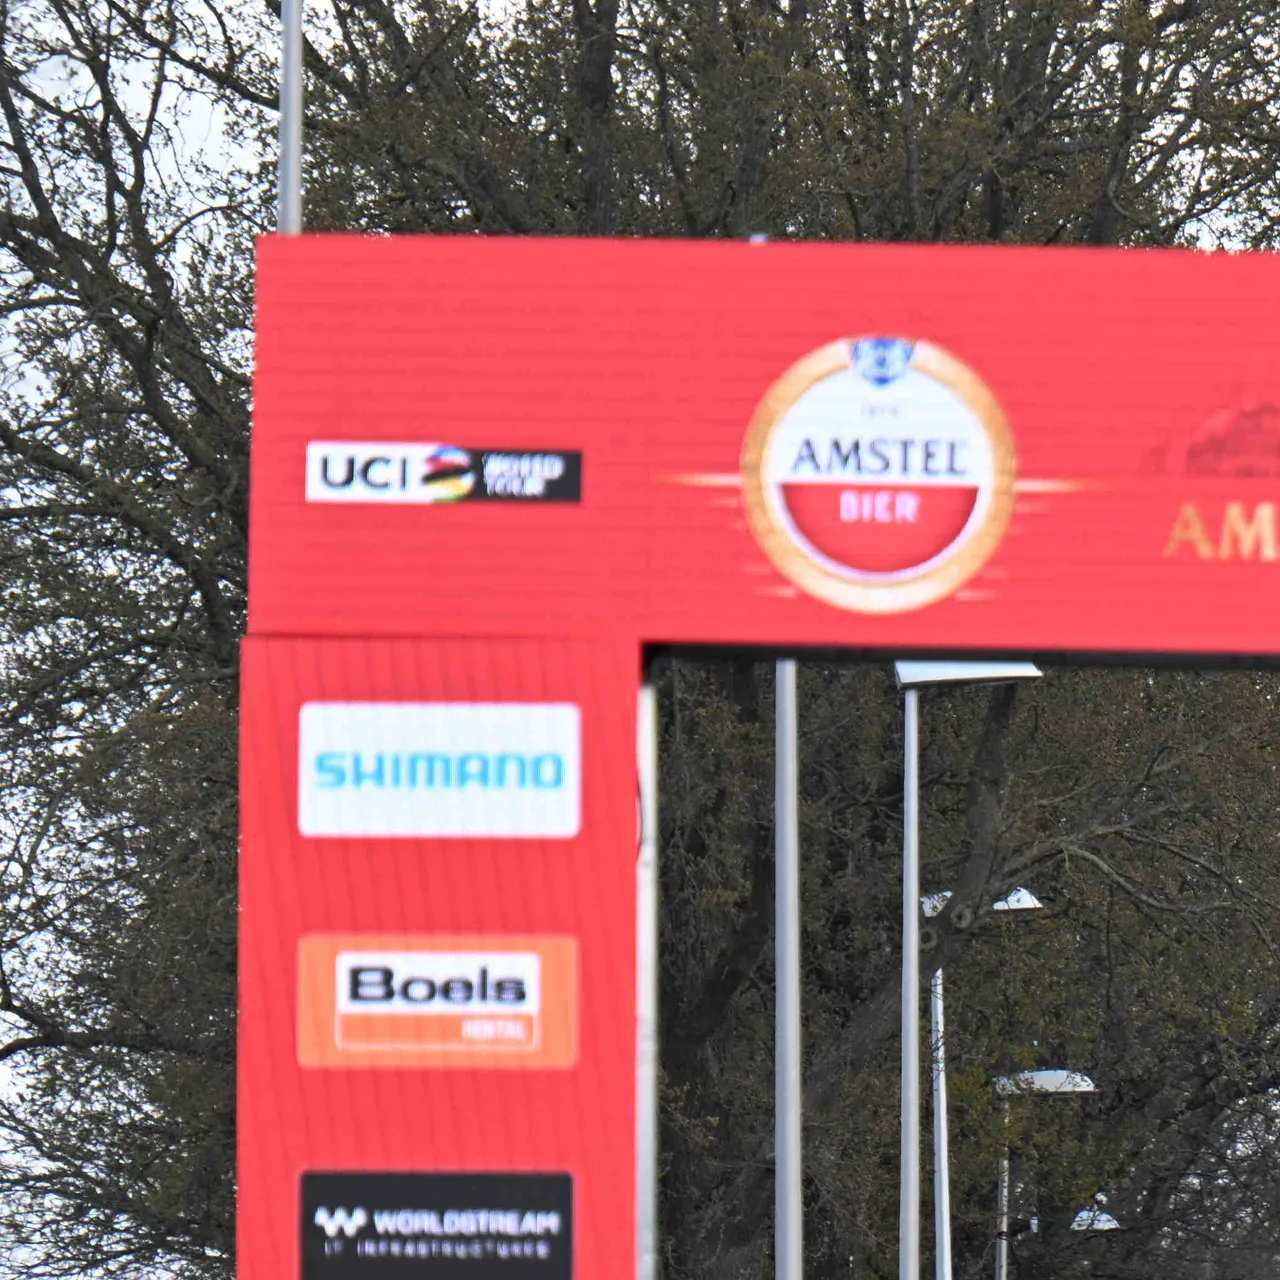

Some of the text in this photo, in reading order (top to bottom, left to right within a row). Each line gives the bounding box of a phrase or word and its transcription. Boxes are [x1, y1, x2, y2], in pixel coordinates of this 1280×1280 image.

[321, 455, 407, 491] UCI
[792, 437, 969, 477] AMSTEL
[839, 489, 921, 523] BIER
[313, 750, 565, 790] SHIMANO
[348, 965, 527, 1004] Boels
